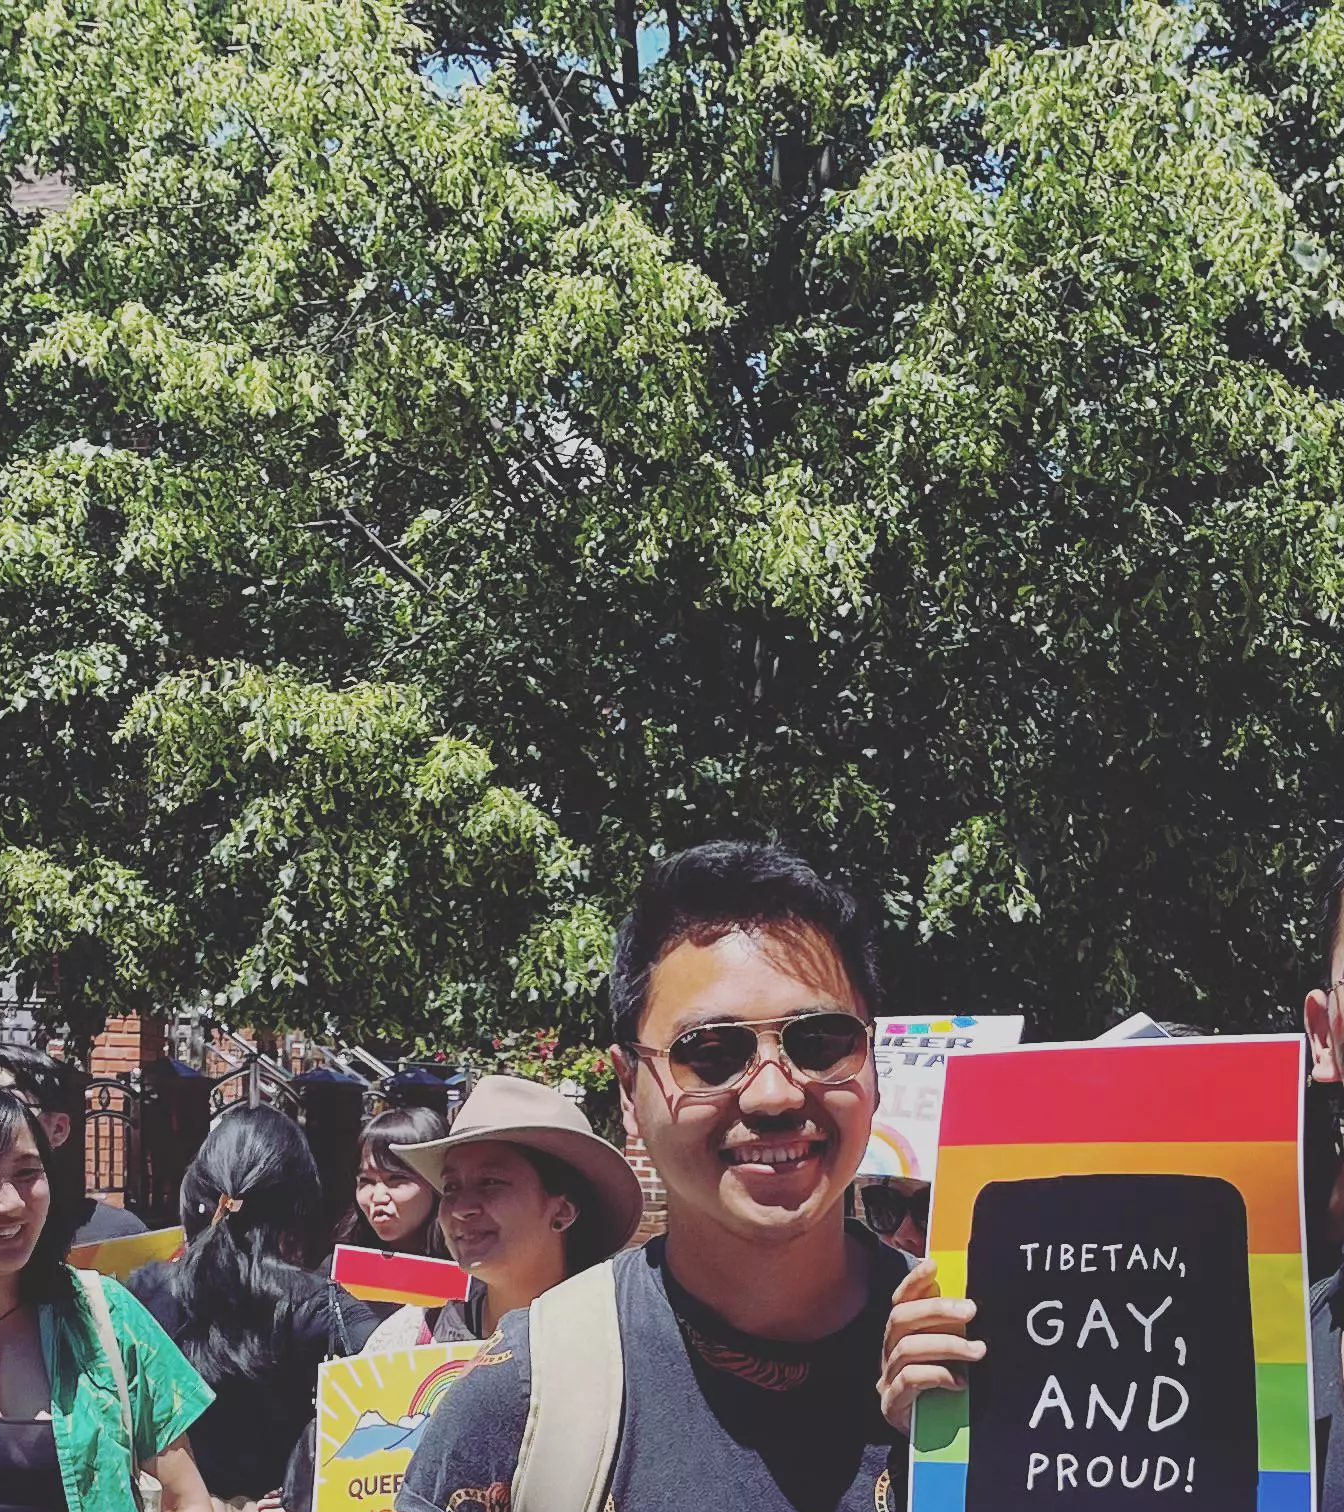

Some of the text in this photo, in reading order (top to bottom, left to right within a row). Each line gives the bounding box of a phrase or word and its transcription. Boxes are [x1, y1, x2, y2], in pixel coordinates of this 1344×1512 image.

[879, 1036, 975, 1049] EER
[1018, 1242, 1188, 1278] TIBETAN,
[1025, 1295, 1189, 1366] GAY,
[1028, 1374, 1191, 1433] AND
[349, 1474, 404, 1499] QUEE
[1026, 1452, 1196, 1494] PROUD!
